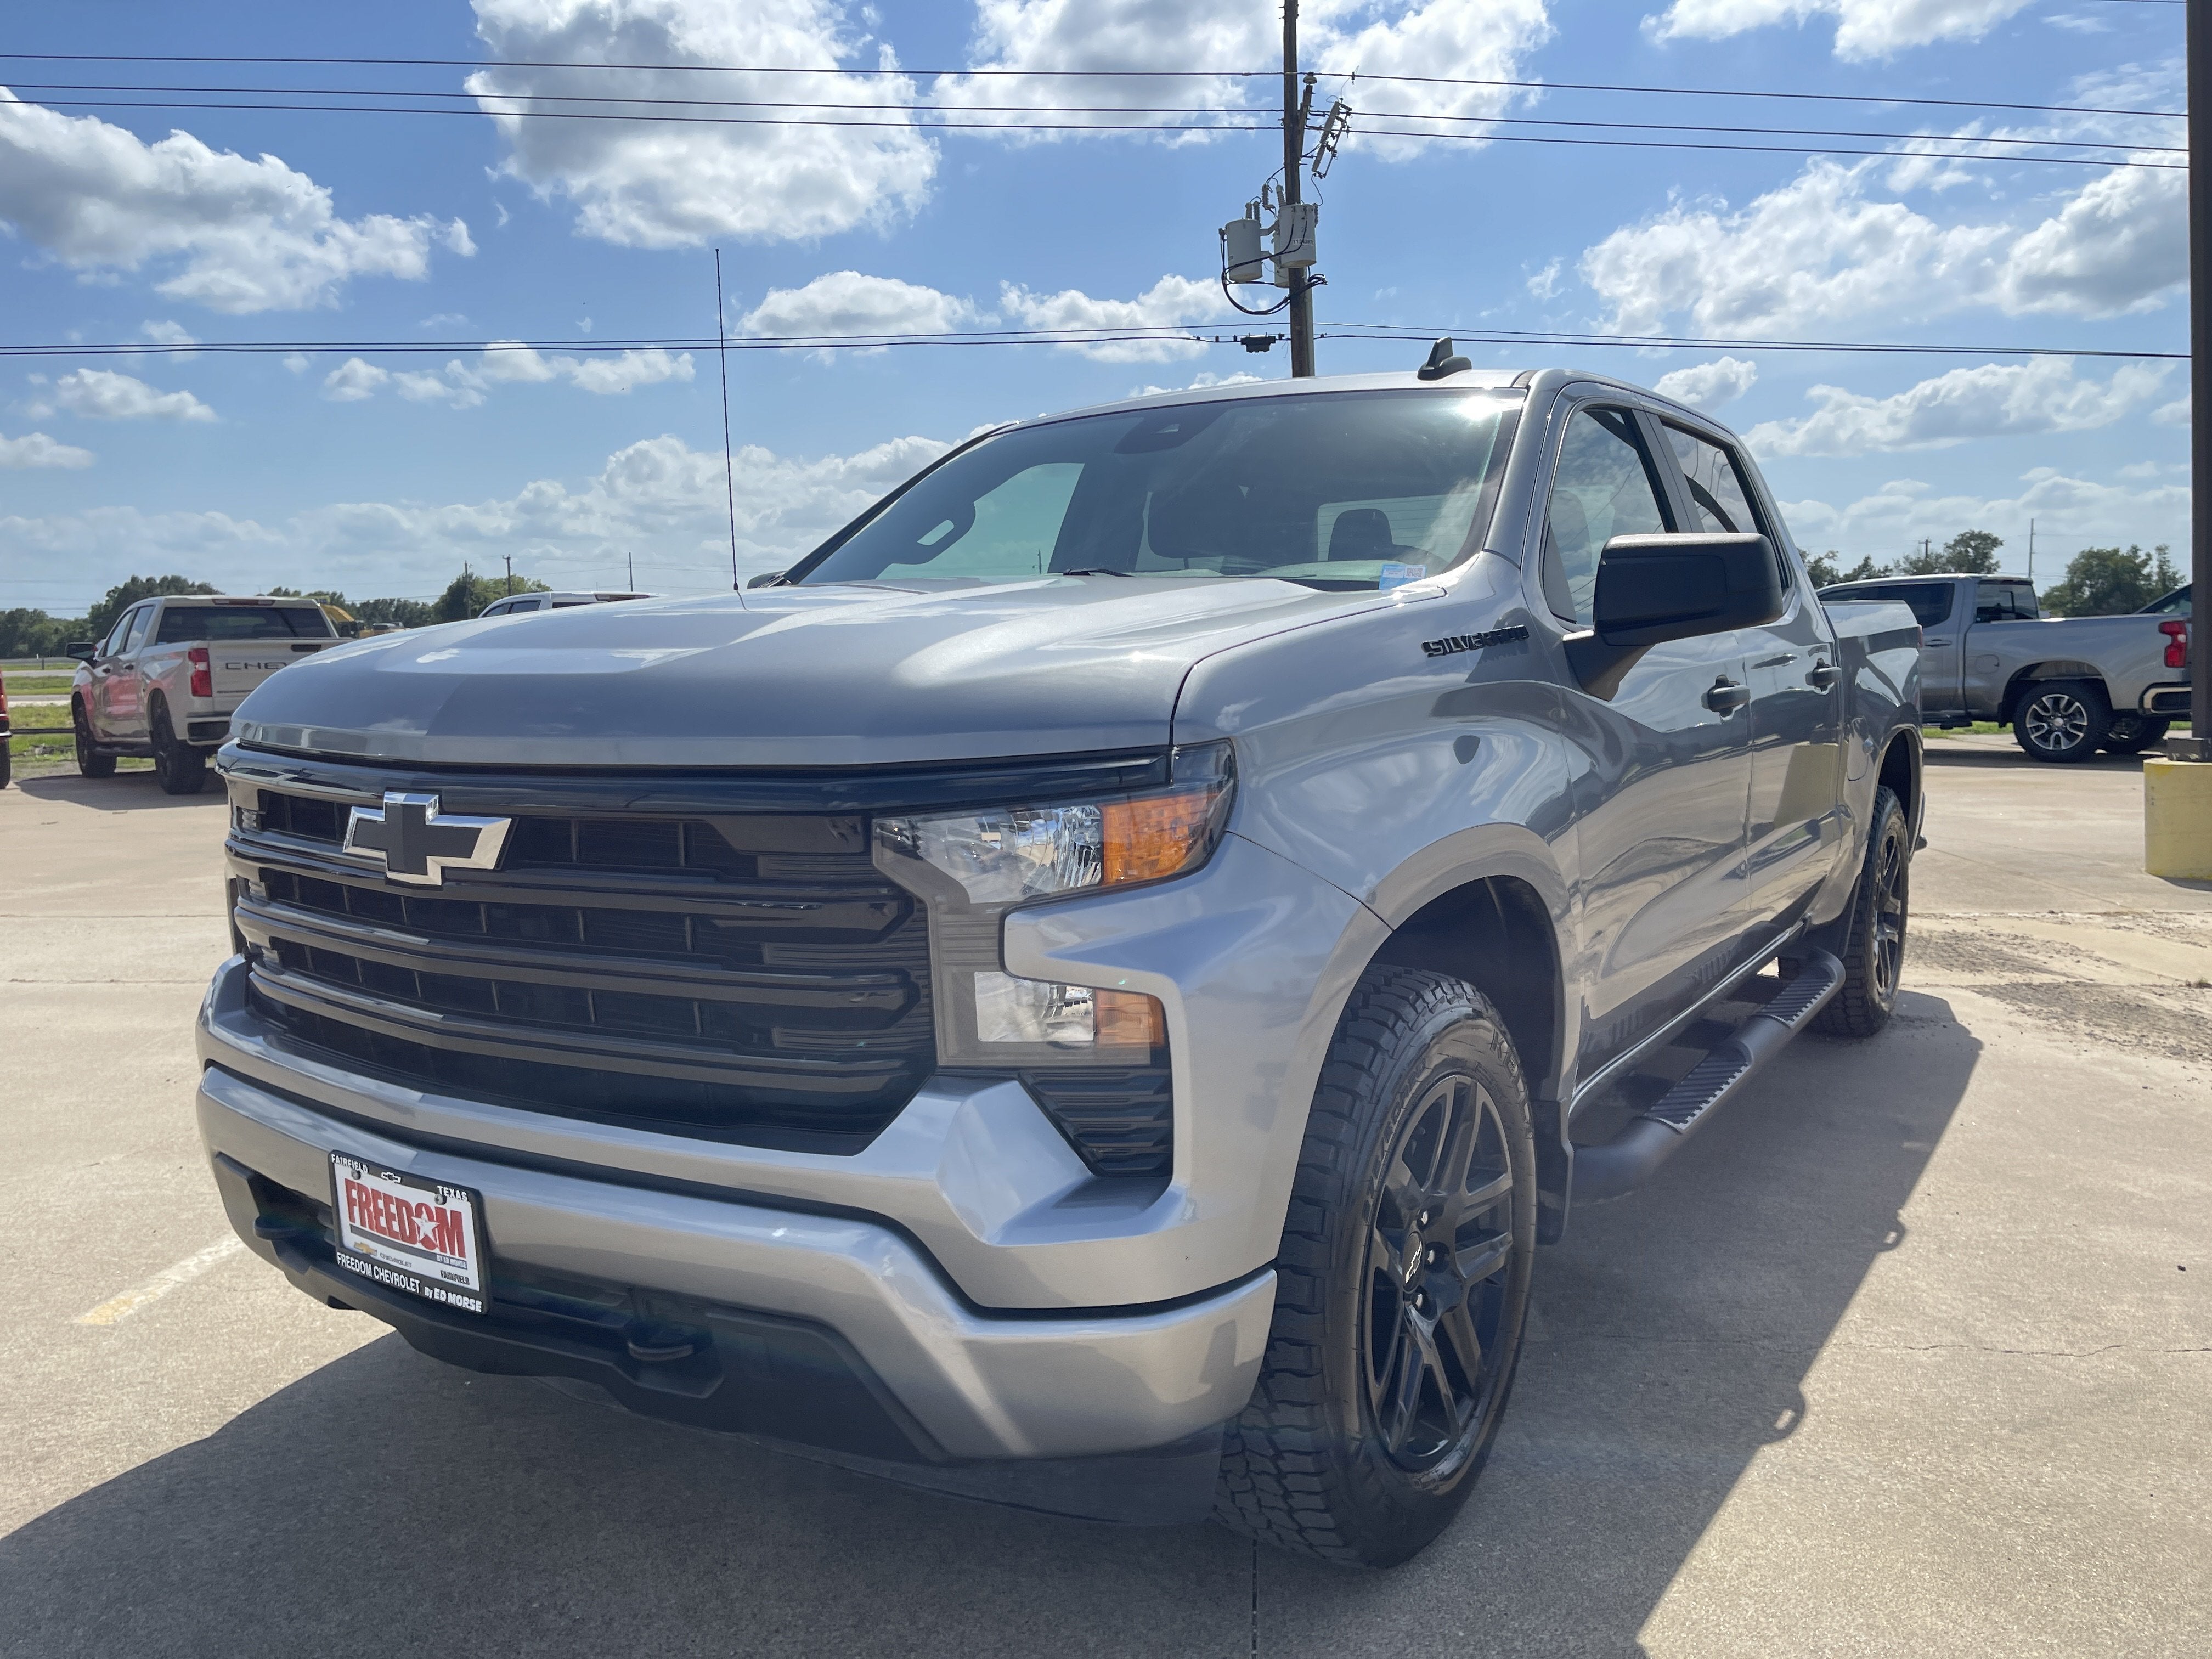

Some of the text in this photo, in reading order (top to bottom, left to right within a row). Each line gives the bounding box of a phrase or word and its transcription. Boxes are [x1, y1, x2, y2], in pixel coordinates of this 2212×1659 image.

[331, 1154, 368, 1173] FAIRFIELD
[437, 1185, 468, 1201] TEXAS
[345, 1178, 466, 1259] FREEDOM
[336, 1251, 372, 1277] FREEDOM
[374, 1265, 420, 1293] CHEVROLET
[434, 1288, 447, 1301] ED
[448, 1292, 482, 1312] MORSE
